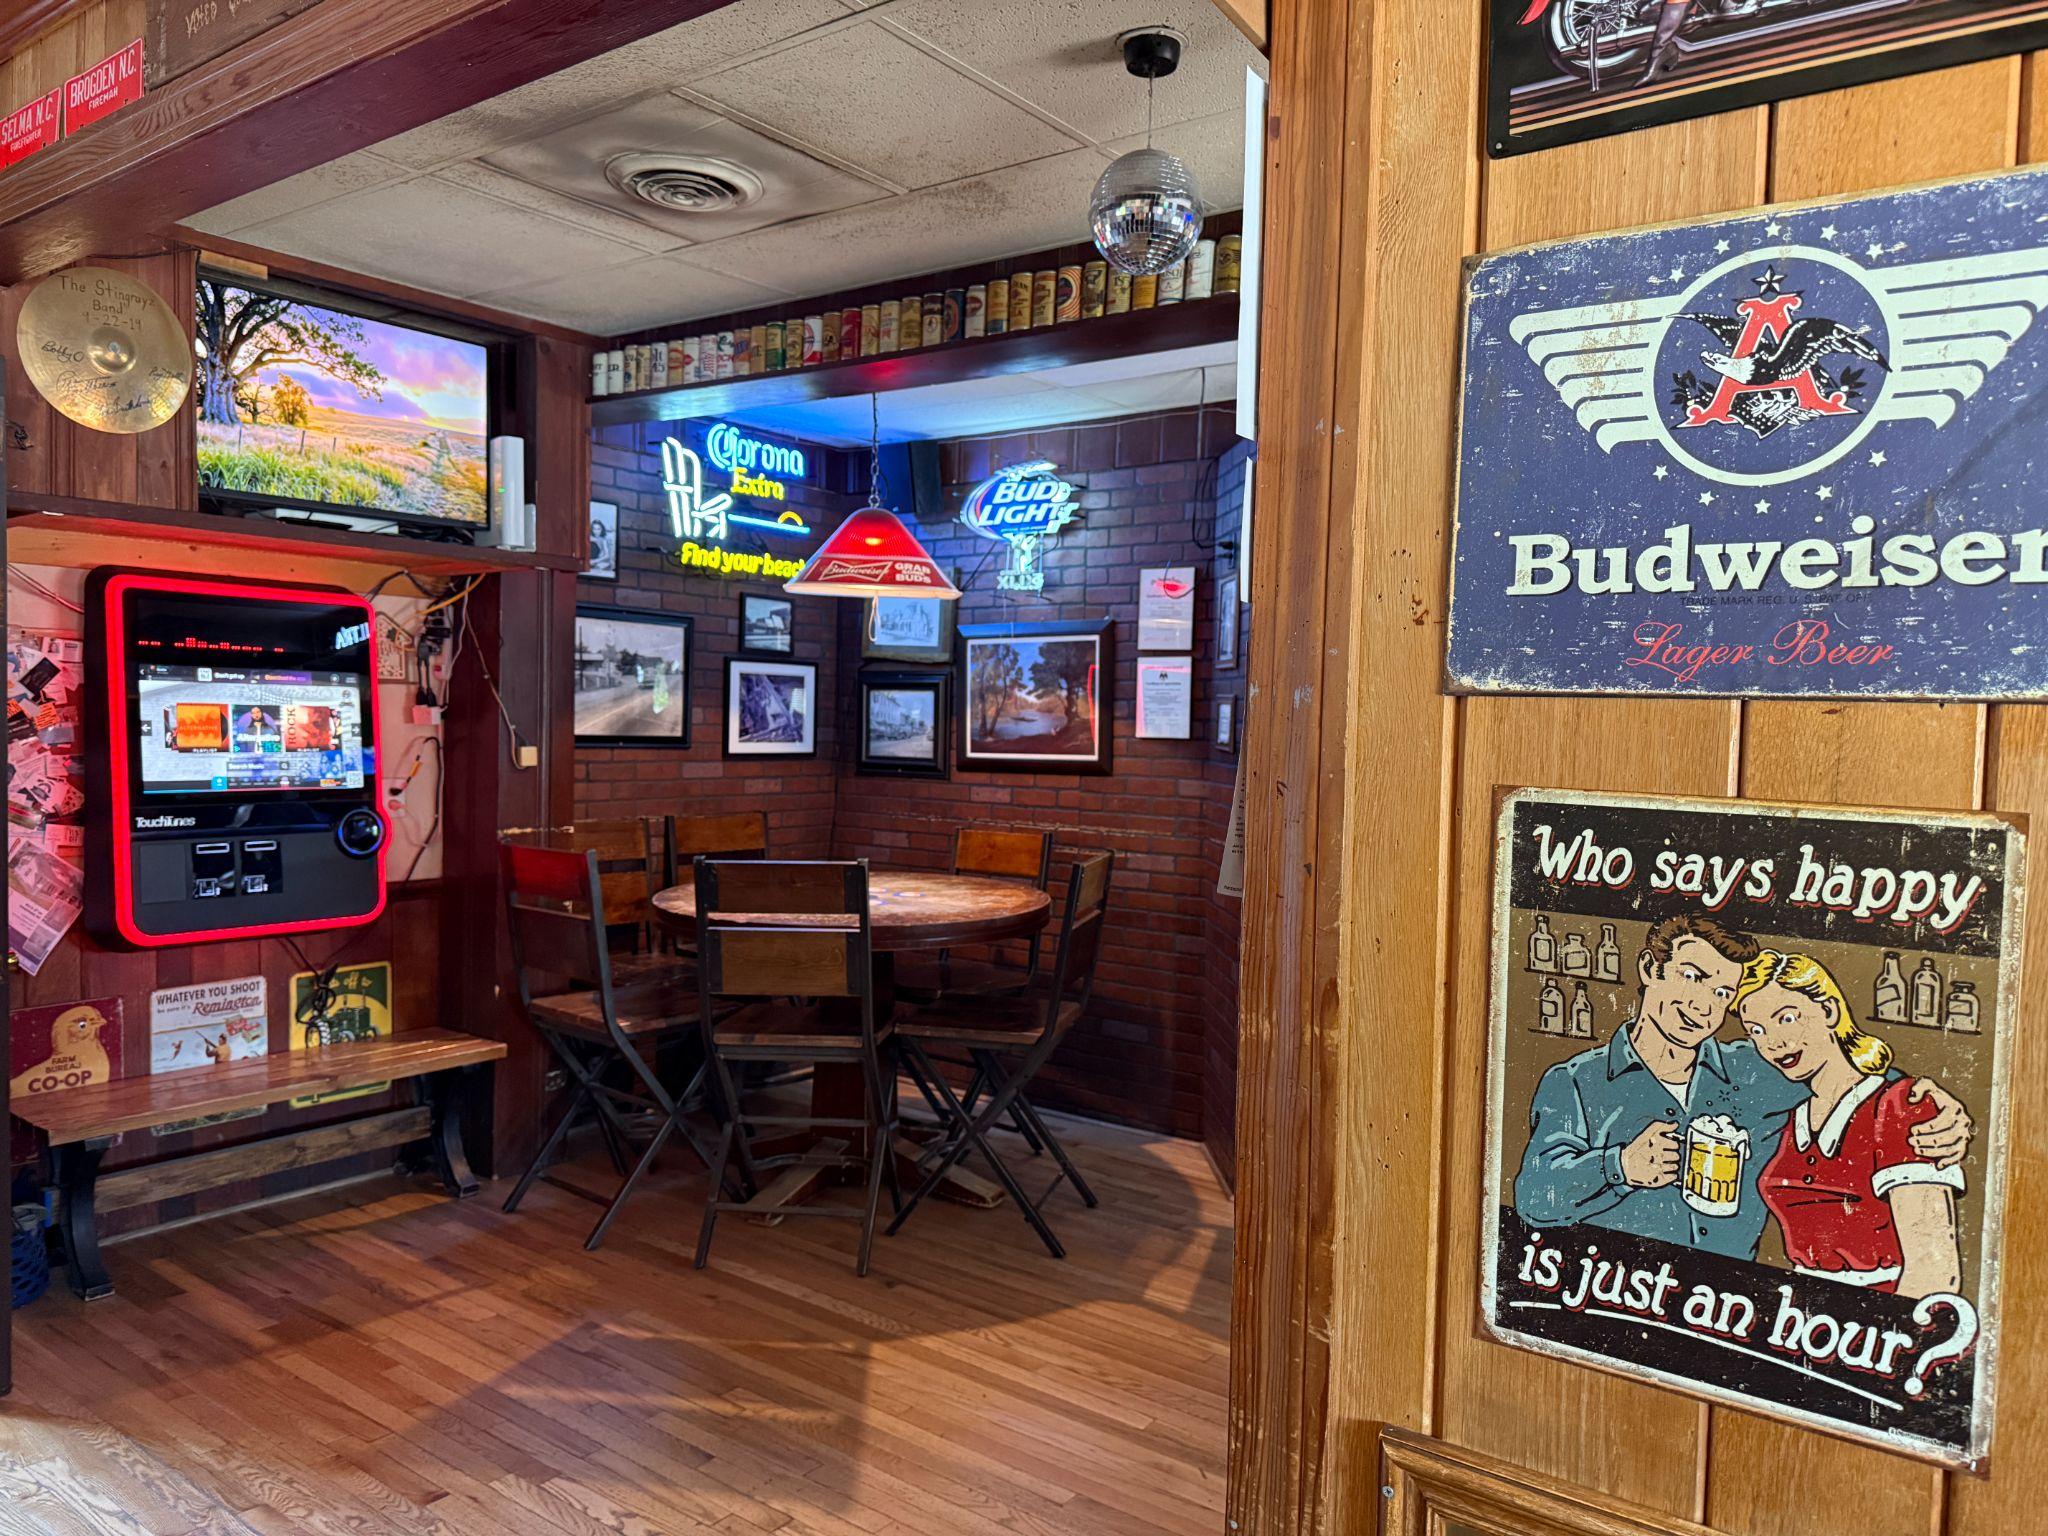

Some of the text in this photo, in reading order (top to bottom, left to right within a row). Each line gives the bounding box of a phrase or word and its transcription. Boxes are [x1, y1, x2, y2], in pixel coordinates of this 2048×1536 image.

[70, 48, 137, 108] BROGDEN N.C.
[88, 86, 119, 111] FIREMAN
[1, 97, 54, 145] SELMA N.C.
[57, 275, 156, 312] The Stingrays
[707, 422, 805, 477] Corona
[730, 466, 785, 500] Extra
[992, 480, 1062, 504] BUD
[978, 501, 1067, 527] LIGHT
[681, 541, 721, 569] Find
[720, 551, 764, 573] your
[826, 563, 890, 576] Budweiser
[1505, 515, 2048, 597] Budweiser
[1680, 597, 1717, 606] TRADE
[1720, 596, 1754, 605] MARK
[1626, 618, 1893, 682] Lager Beer
[286, 705, 298, 745] ROCK
[135, 815, 196, 828] TouchTunes
[1534, 825, 1985, 932] Who says happy
[156, 981, 260, 1005] WHATEVER YOU SHOOT
[193, 995, 262, 1016] Remington
[52, 1055, 76, 1065] FARM
[28, 1070, 92, 1093] CO-OP
[1518, 1232, 1981, 1397] is just an hour?
